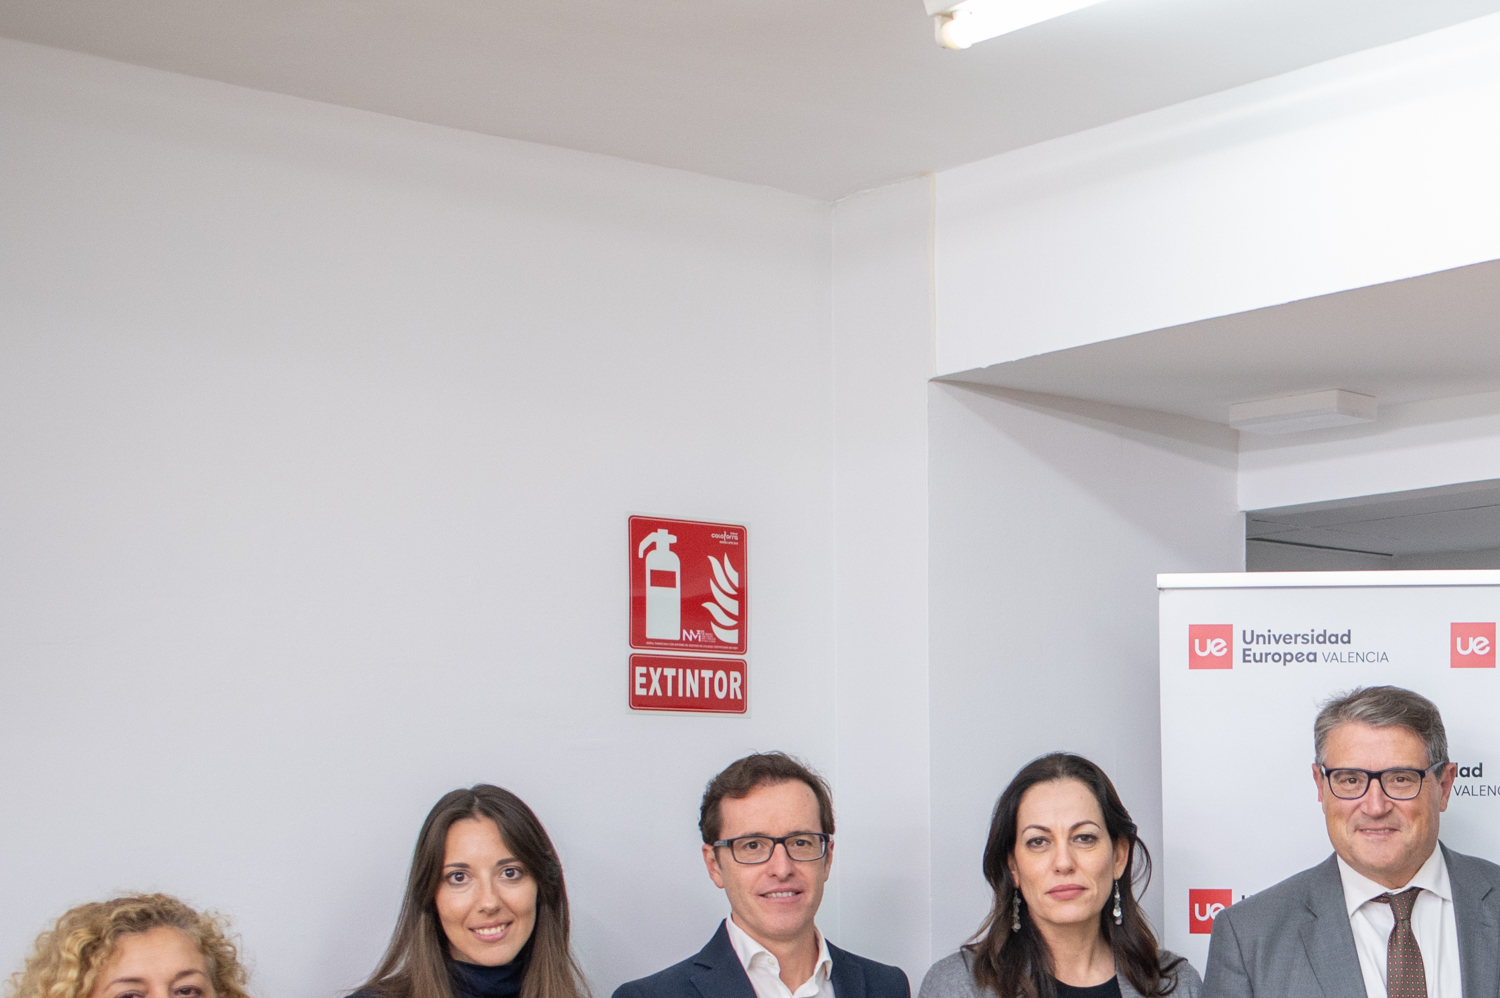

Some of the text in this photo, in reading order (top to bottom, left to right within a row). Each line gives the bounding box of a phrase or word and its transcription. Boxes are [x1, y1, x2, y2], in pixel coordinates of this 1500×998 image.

[1194, 637, 1228, 657] ue
[1242, 629, 1352, 645] Universidad
[1456, 636, 1491, 656] ue
[1242, 647, 1390, 666] Europea VALENCIA
[635, 666, 743, 700] EXTINTOR
